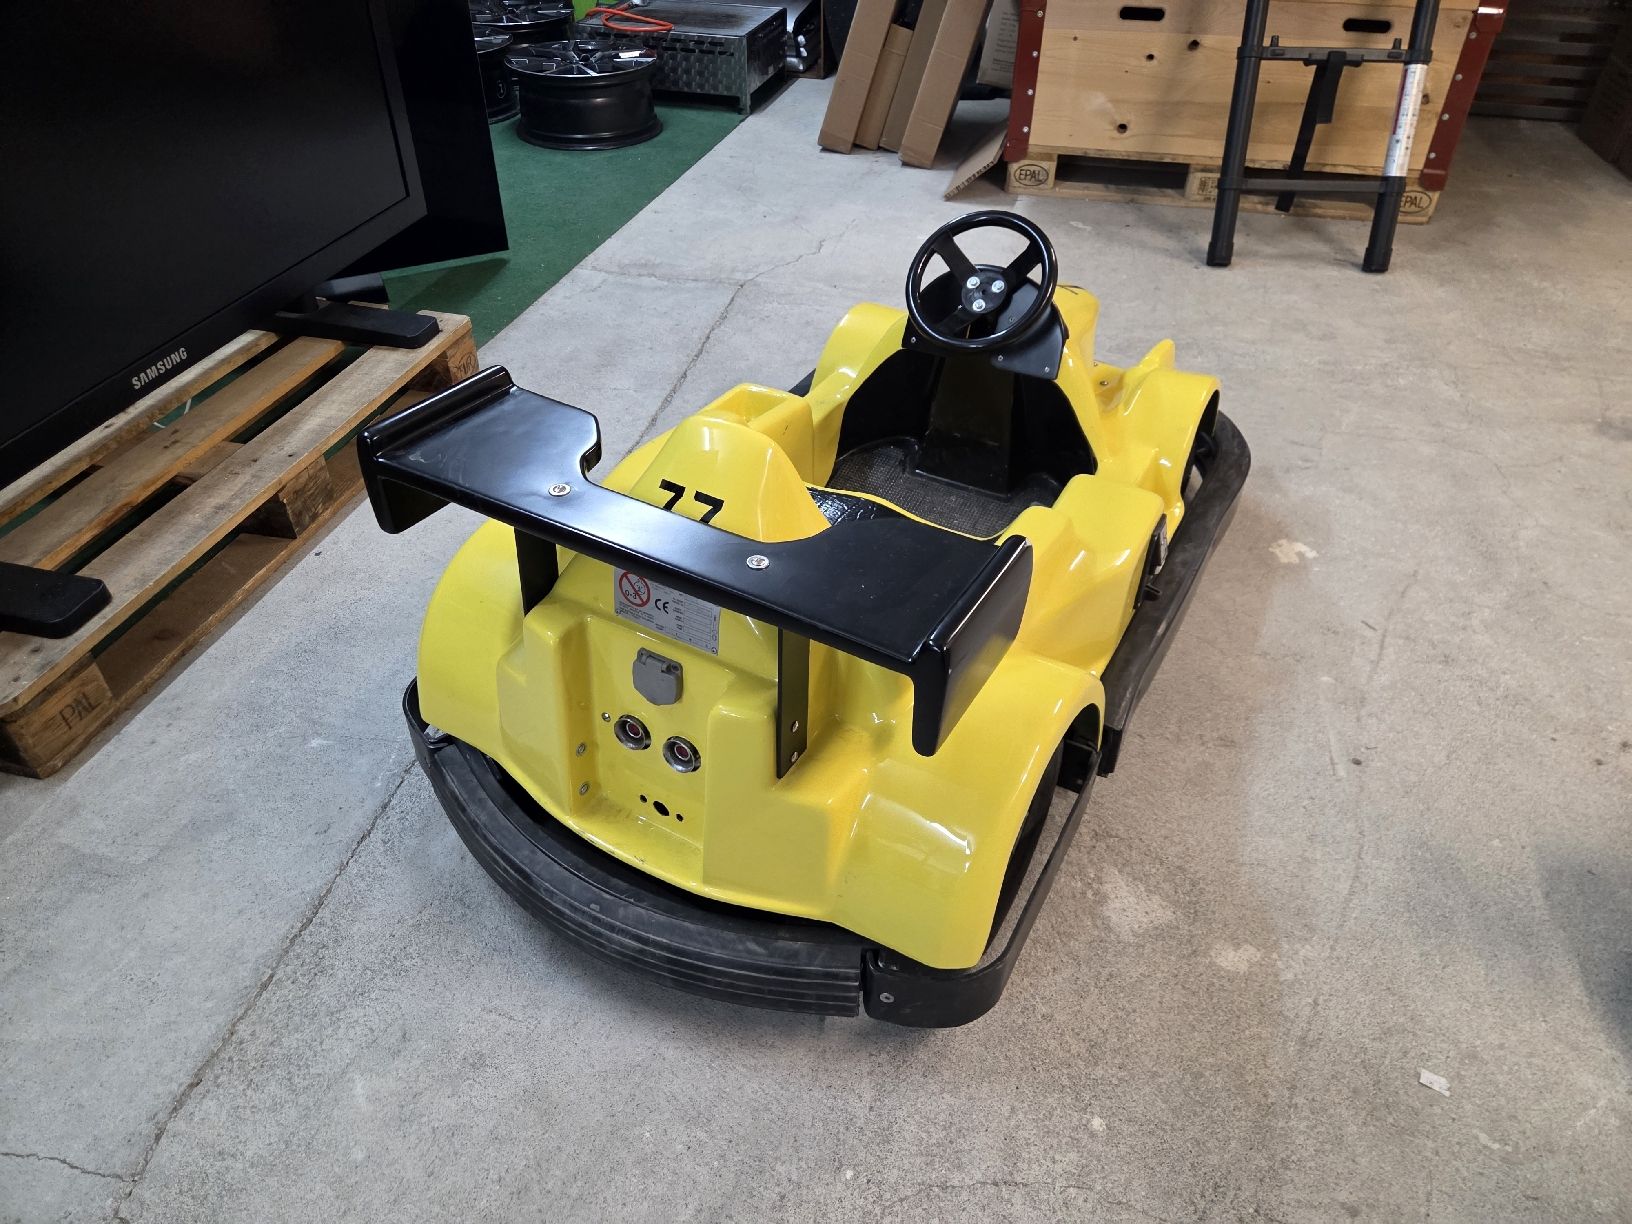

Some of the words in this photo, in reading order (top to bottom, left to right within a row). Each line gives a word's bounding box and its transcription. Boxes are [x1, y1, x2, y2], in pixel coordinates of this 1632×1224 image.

[1018, 168, 1044, 183] EPAL
[131, 347, 188, 390] SAMSUNG
[658, 478, 725, 524] 77
[654, 598, 670, 615] CE
